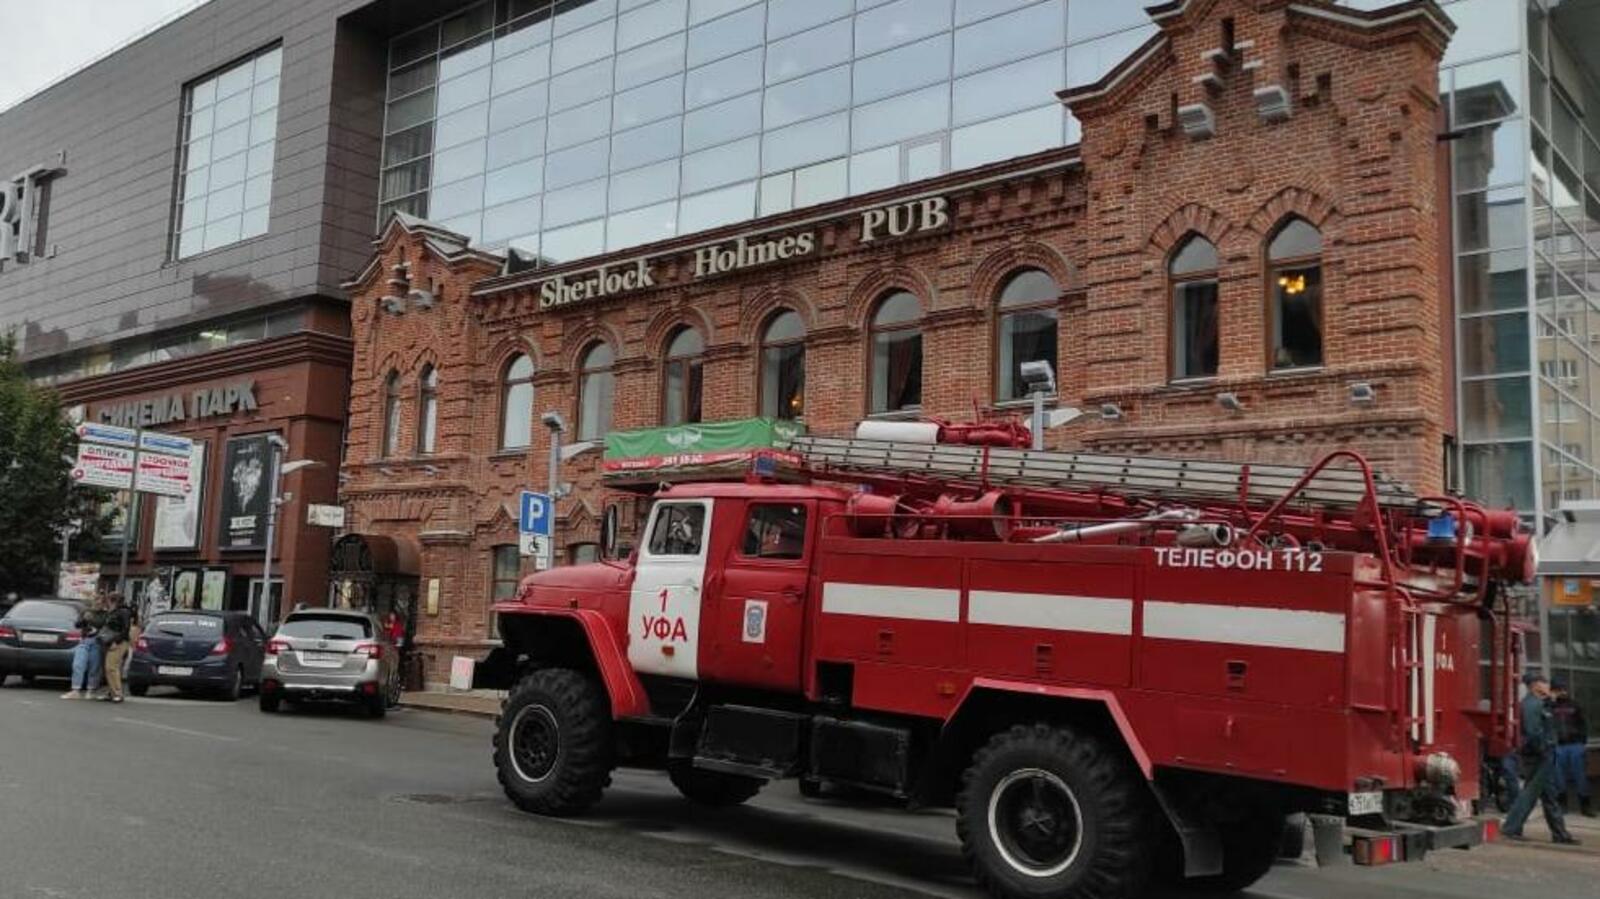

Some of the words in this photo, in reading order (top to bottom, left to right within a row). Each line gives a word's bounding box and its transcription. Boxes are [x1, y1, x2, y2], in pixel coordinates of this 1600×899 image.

[539, 257, 654, 309] Sherlock
[693, 231, 815, 279] Holmes
[860, 196, 950, 243] PUB
[98, 393, 185, 427] СИНЕМА
[191, 378, 258, 419] ПАРК
[528, 497, 544, 529] P
[1154, 547, 1273, 570] ТЕЛЕФОН
[1282, 547, 1323, 572] 112
[659, 588, 668, 613] 1
[642, 614, 688, 643] УФА
